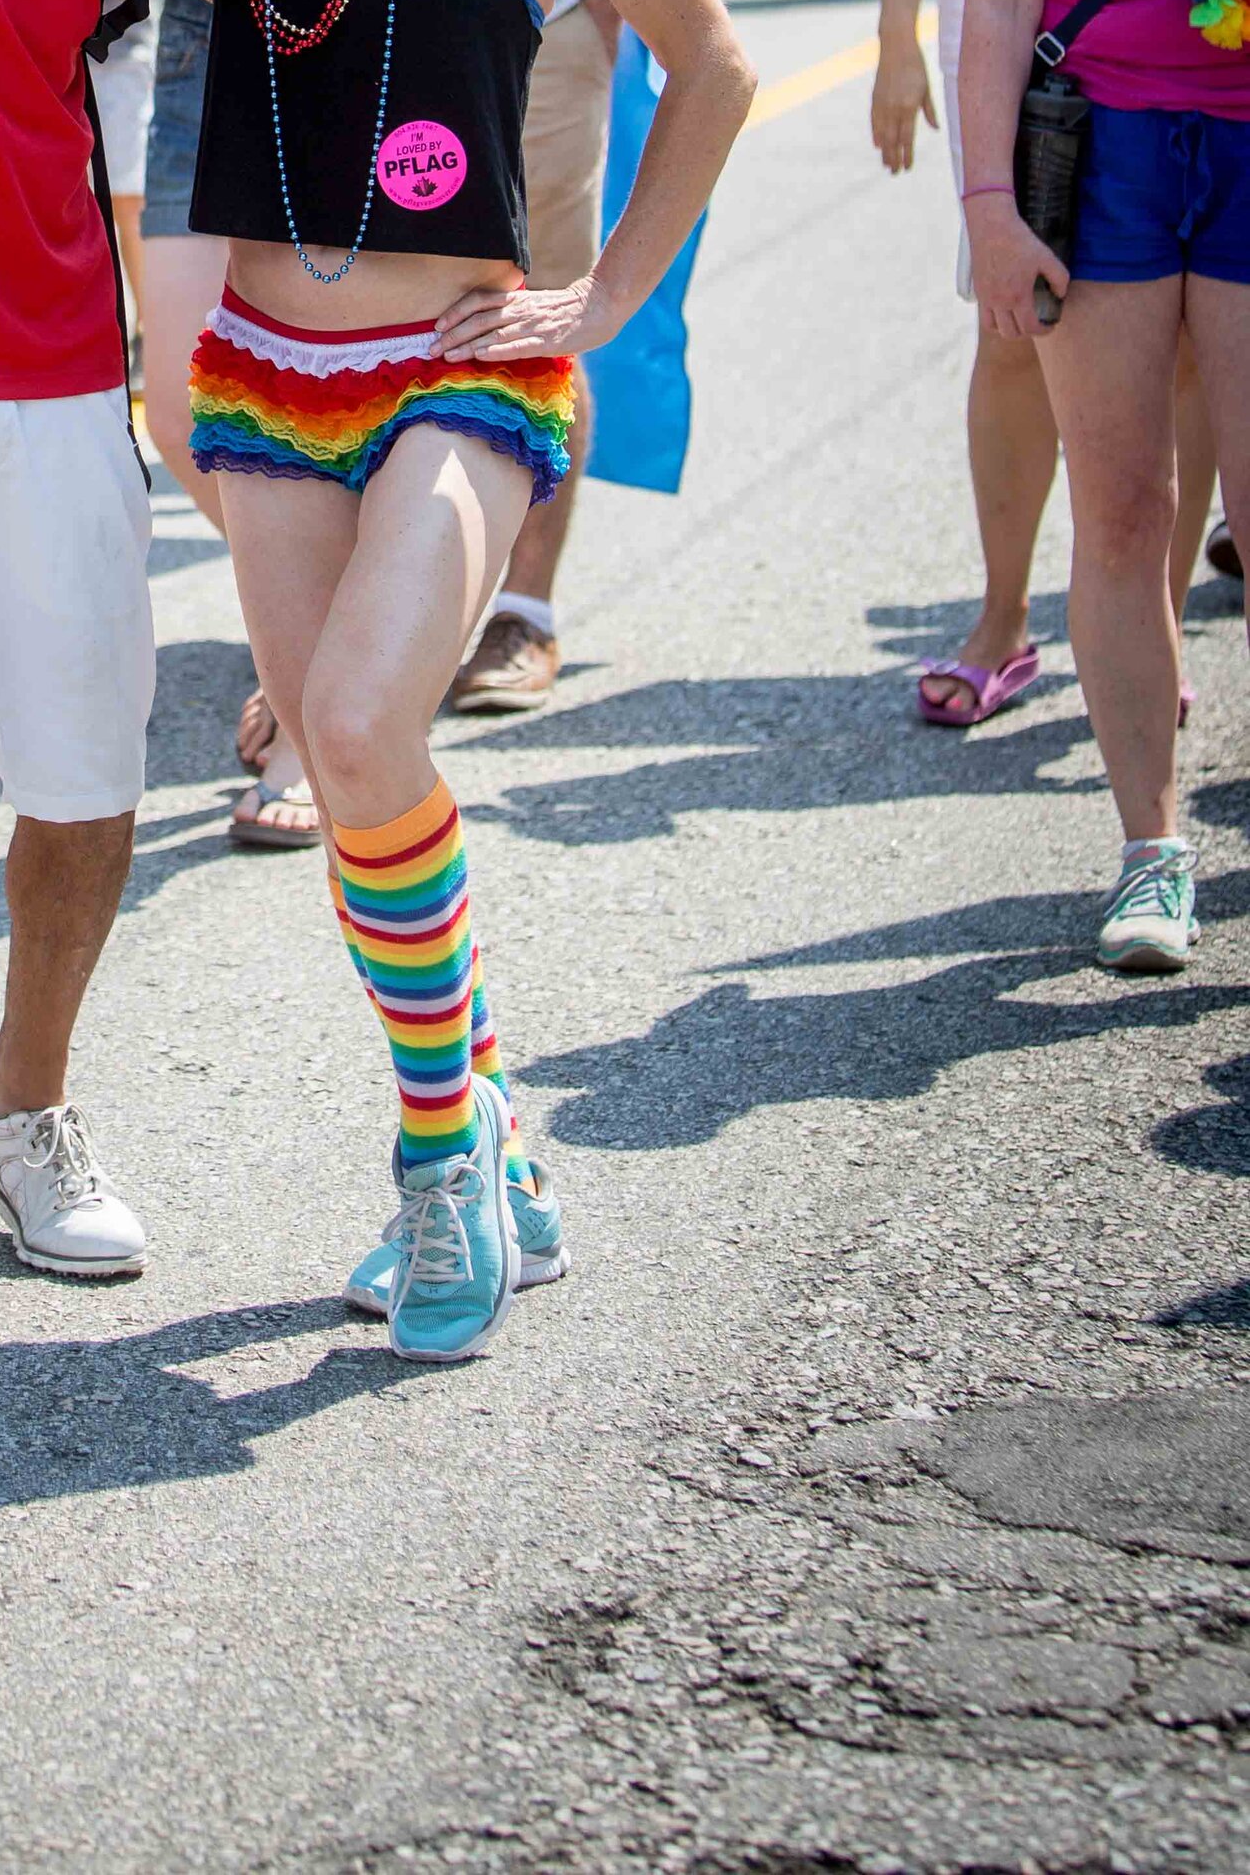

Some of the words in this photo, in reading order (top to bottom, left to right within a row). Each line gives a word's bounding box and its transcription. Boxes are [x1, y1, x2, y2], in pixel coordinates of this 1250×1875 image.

[411, 132, 424, 143] I'M
[396, 142, 427, 156] LOVED
[429, 140, 442, 151] BY
[384, 151, 458, 179] PFLAG
